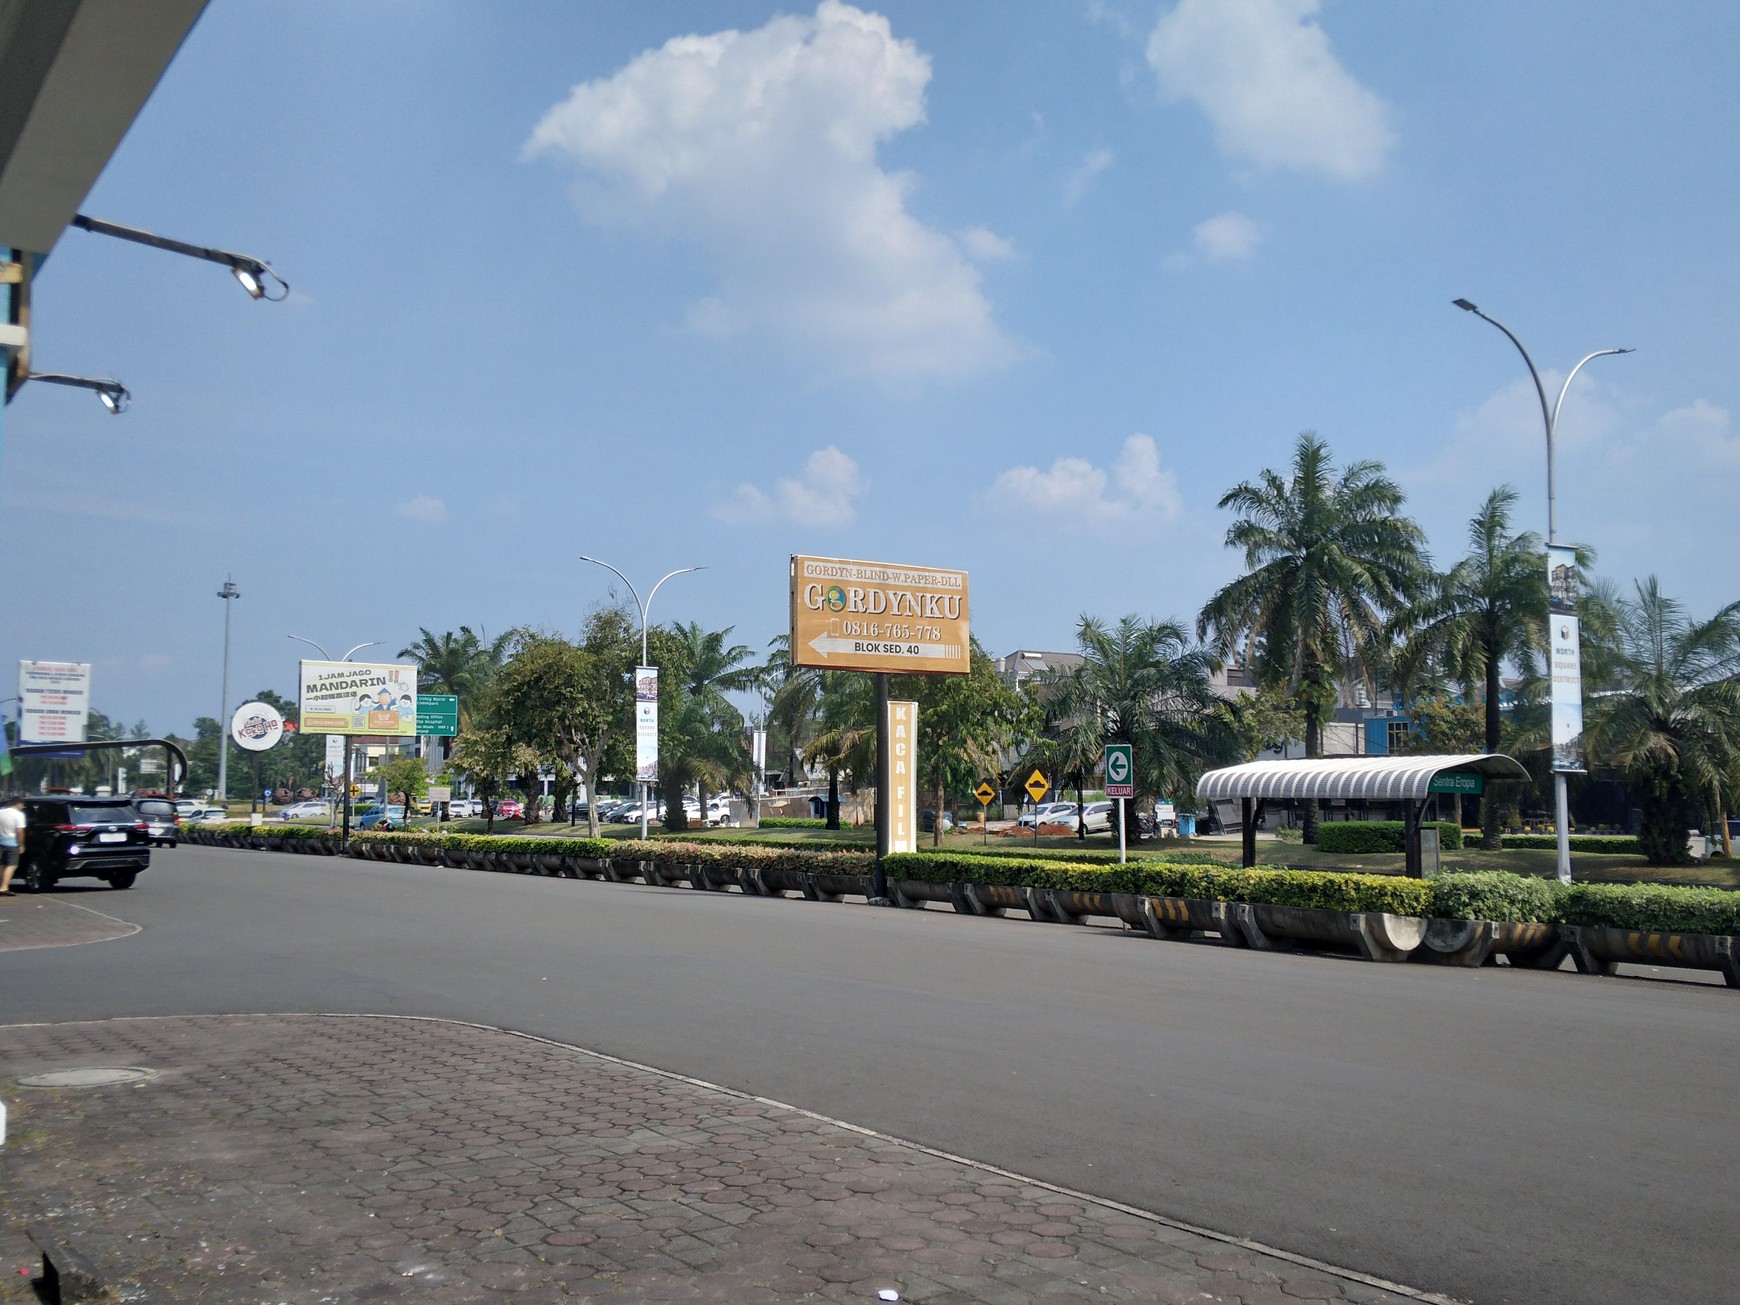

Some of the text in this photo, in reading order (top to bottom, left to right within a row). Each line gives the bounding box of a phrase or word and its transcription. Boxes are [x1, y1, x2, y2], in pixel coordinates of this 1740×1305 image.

[843, 620, 942, 640] 0816-765-778
[854, 642, 920, 655] BLOK SED. 40
[1555, 662, 1577, 670] SQUARE
[306, 676, 386, 694] MANDARIN
[1552, 675, 1580, 683] DISTRICT
[895, 707, 907, 774] KACA
[1455, 776, 1475, 790] Eropa
[1107, 787, 1131, 795] KELUAR
